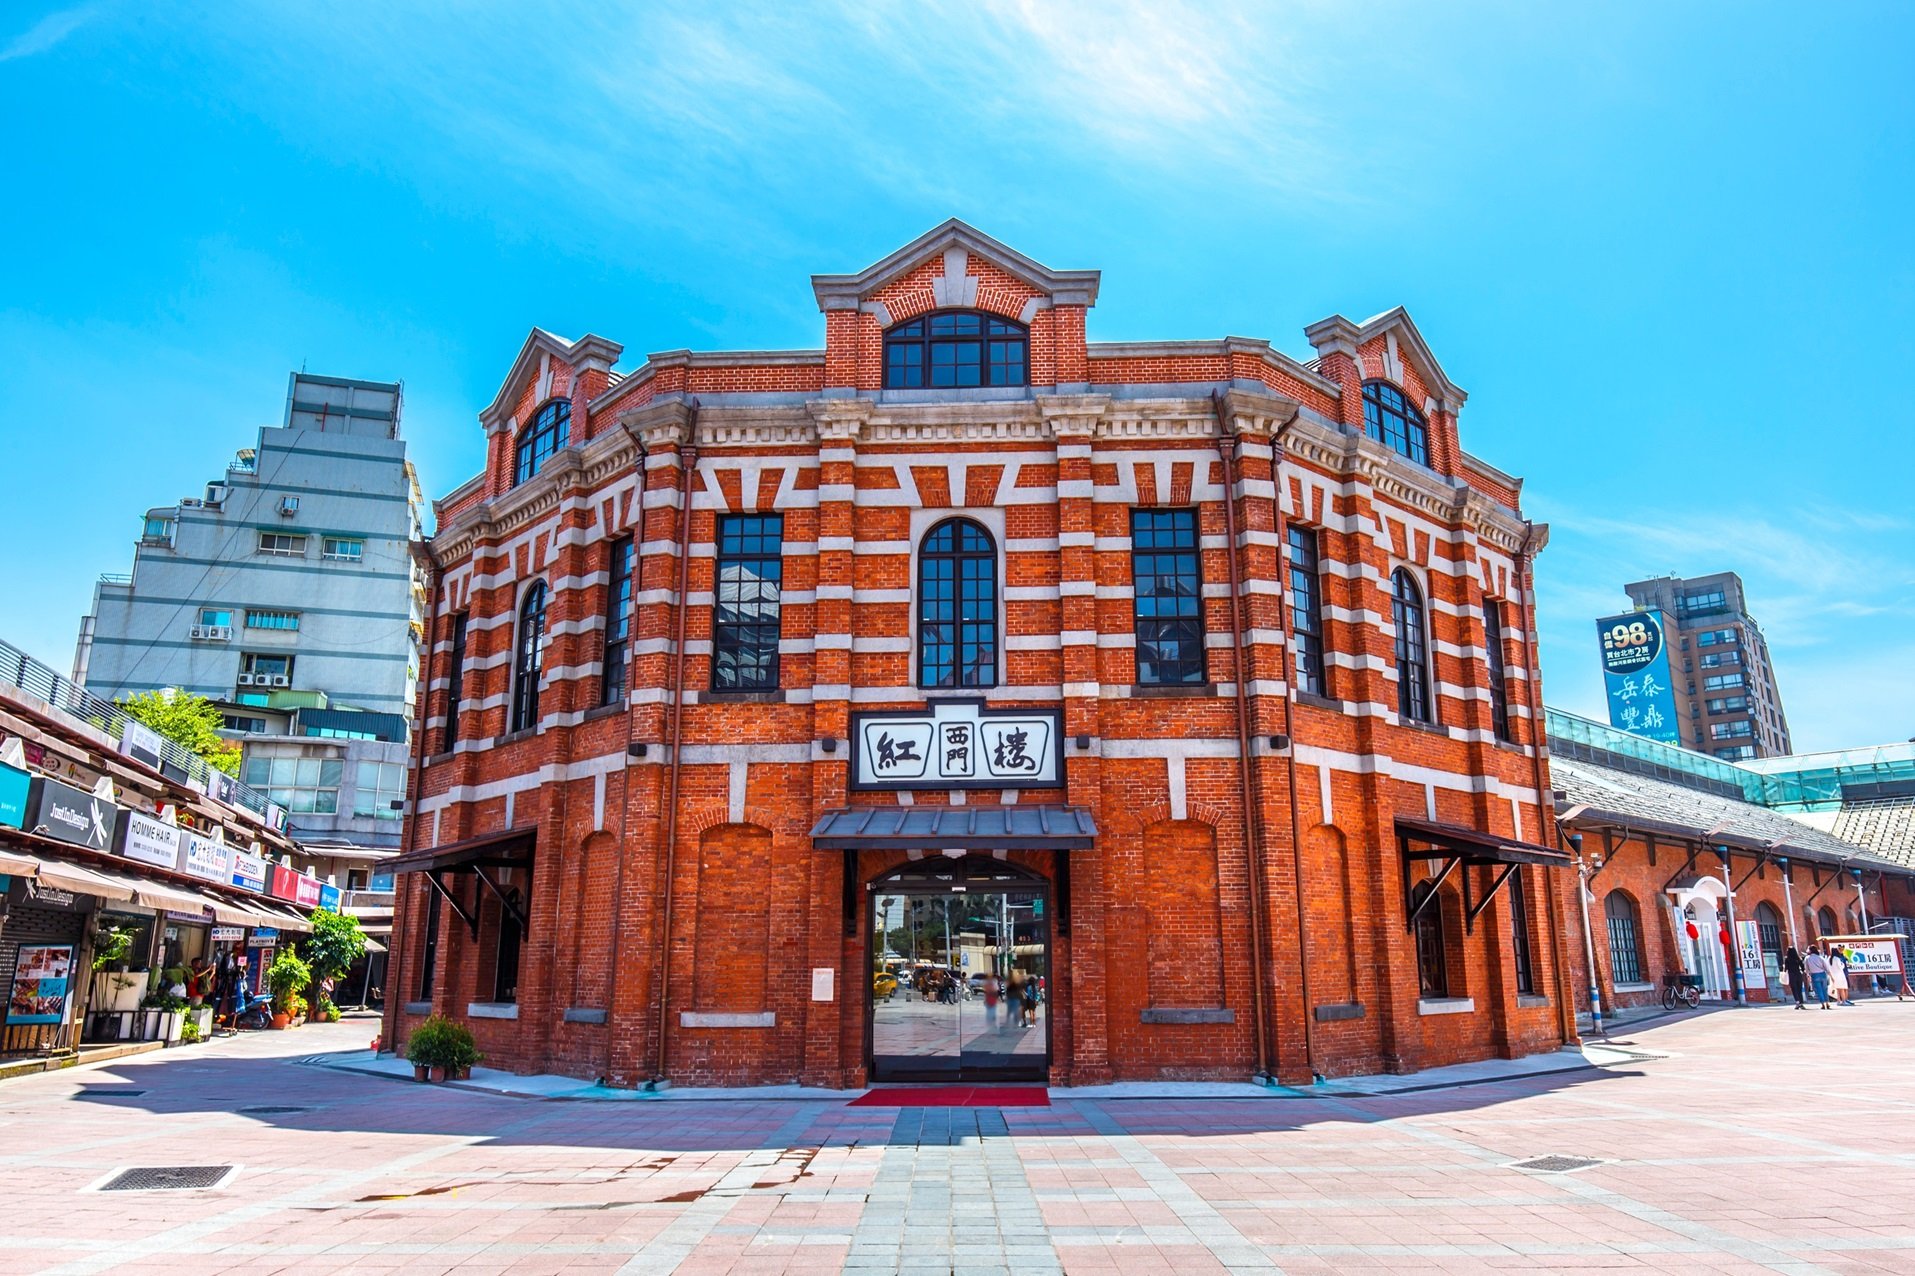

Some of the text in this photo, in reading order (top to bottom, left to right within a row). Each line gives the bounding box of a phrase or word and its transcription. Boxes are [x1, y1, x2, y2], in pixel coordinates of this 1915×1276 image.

[1612, 622, 1647, 648] 98
[1607, 646, 1649, 659] 買台北市2房
[1613, 674, 1665, 700] 岳泰
[876, 731, 922, 770] 紅
[945, 726, 969, 772] 西門
[131, 820, 171, 845] HOMME HAIR
[1742, 950, 1754, 959] 16
[1867, 953, 1892, 963] 16工房
[1745, 960, 1761, 969] 工房
